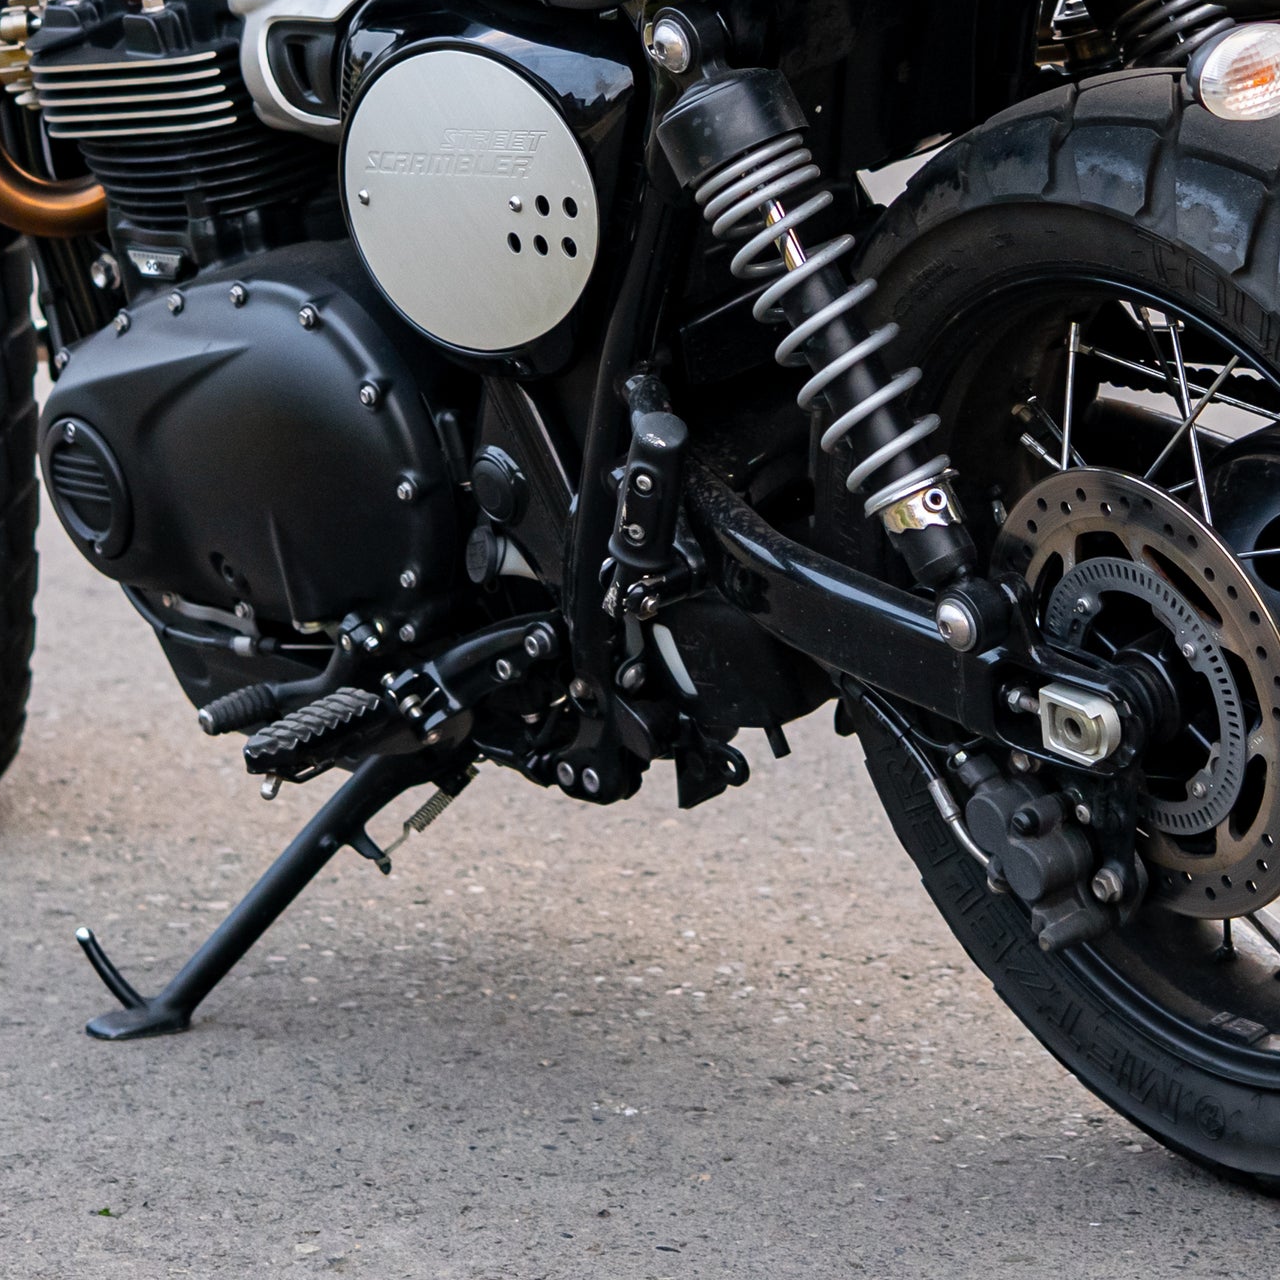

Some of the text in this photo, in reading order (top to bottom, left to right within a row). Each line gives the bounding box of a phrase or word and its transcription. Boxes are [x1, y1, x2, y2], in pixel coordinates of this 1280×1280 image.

[440, 128, 549, 152] STREET
[365, 150, 535, 179] SCRAMBLER
[886, 754, 1184, 1126] METZELER
